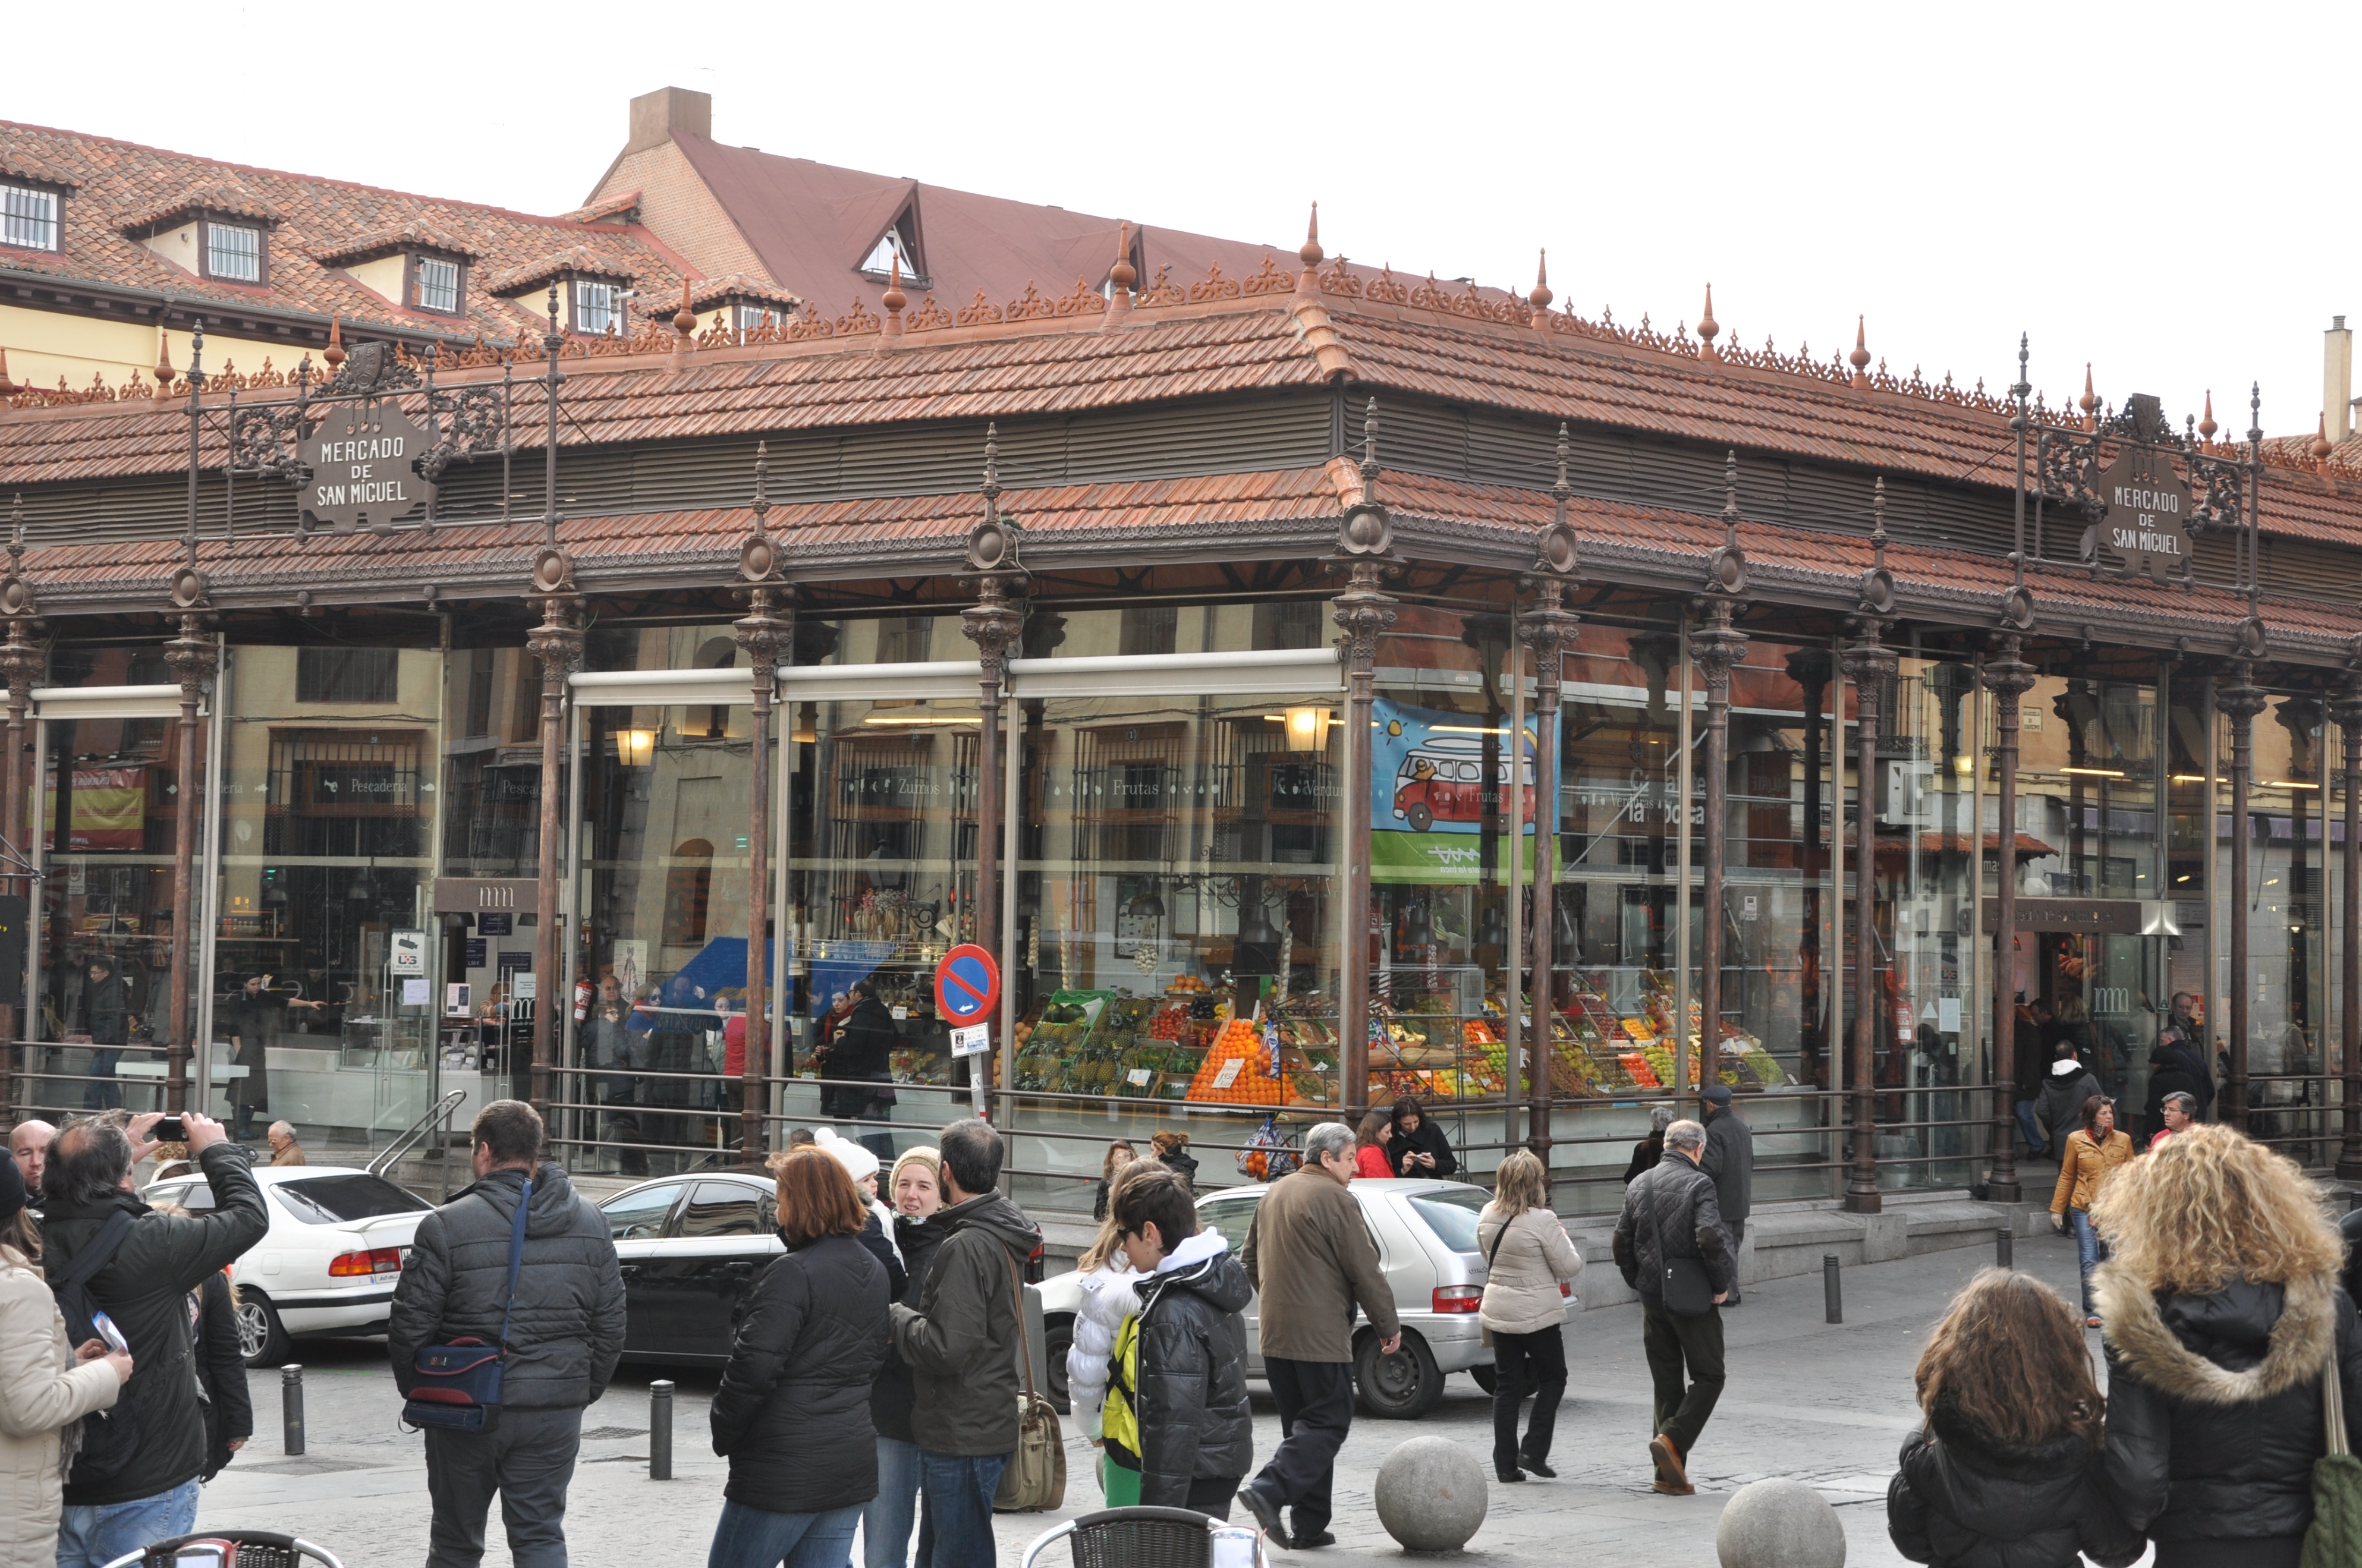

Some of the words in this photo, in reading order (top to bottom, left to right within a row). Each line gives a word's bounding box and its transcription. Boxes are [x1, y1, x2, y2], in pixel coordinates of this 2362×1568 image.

[321, 437, 404, 463] MERCADO
[351, 464, 372, 479] DE
[317, 485, 345, 506] SAN
[2115, 486, 2178, 514] MERCADO
[2139, 513, 2155, 527] DE
[2112, 528, 2137, 549] SAN
[351, 778, 408, 794] Pescadería
[898, 779, 940, 795] Zumos
[1112, 779, 1159, 795] Frutas
[1468, 787, 1504, 804] Frutas
[1610, 792, 1655, 809] Verduras
